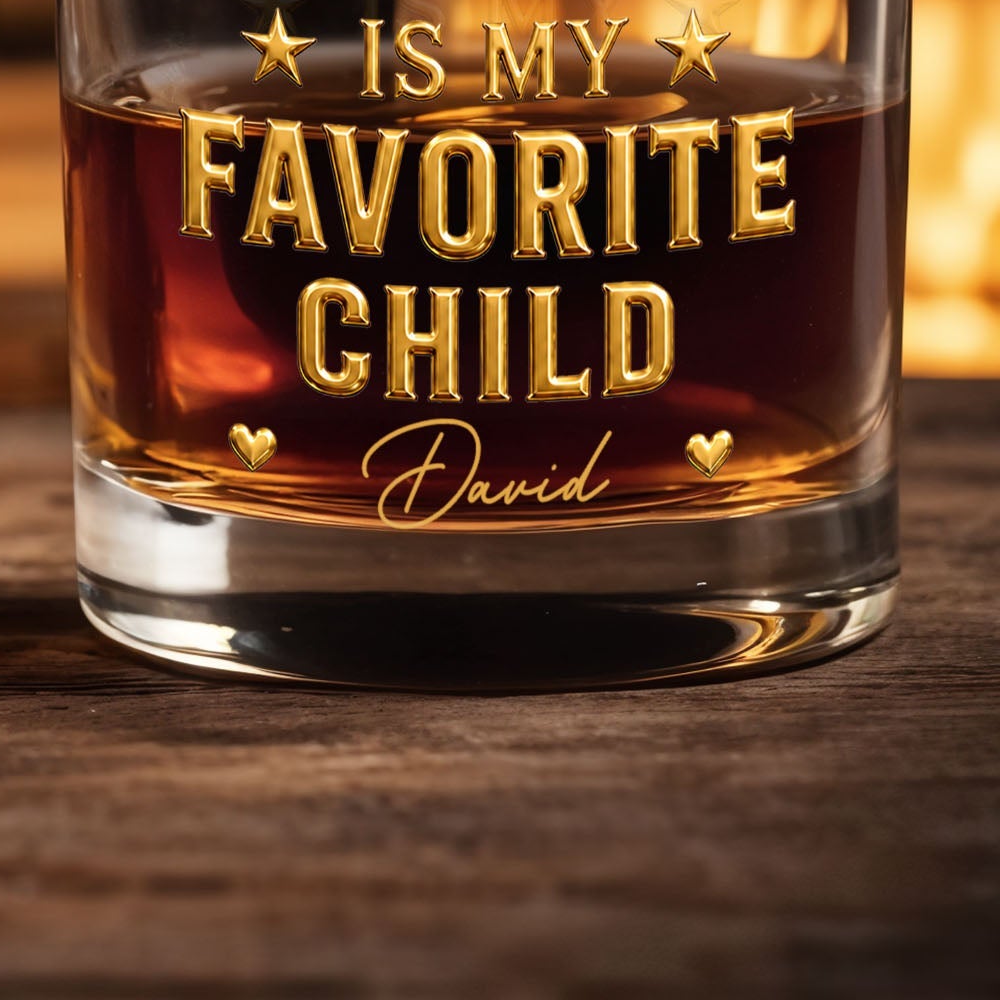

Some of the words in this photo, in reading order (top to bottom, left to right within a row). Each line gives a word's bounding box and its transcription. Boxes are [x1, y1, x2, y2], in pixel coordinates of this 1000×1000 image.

[360, 18, 447, 101] IS
[482, 17, 630, 101] MY
[179, 107, 796, 260] FAVORITE
[296, 277, 676, 402] CHILD
[360, 418, 613, 530] David
